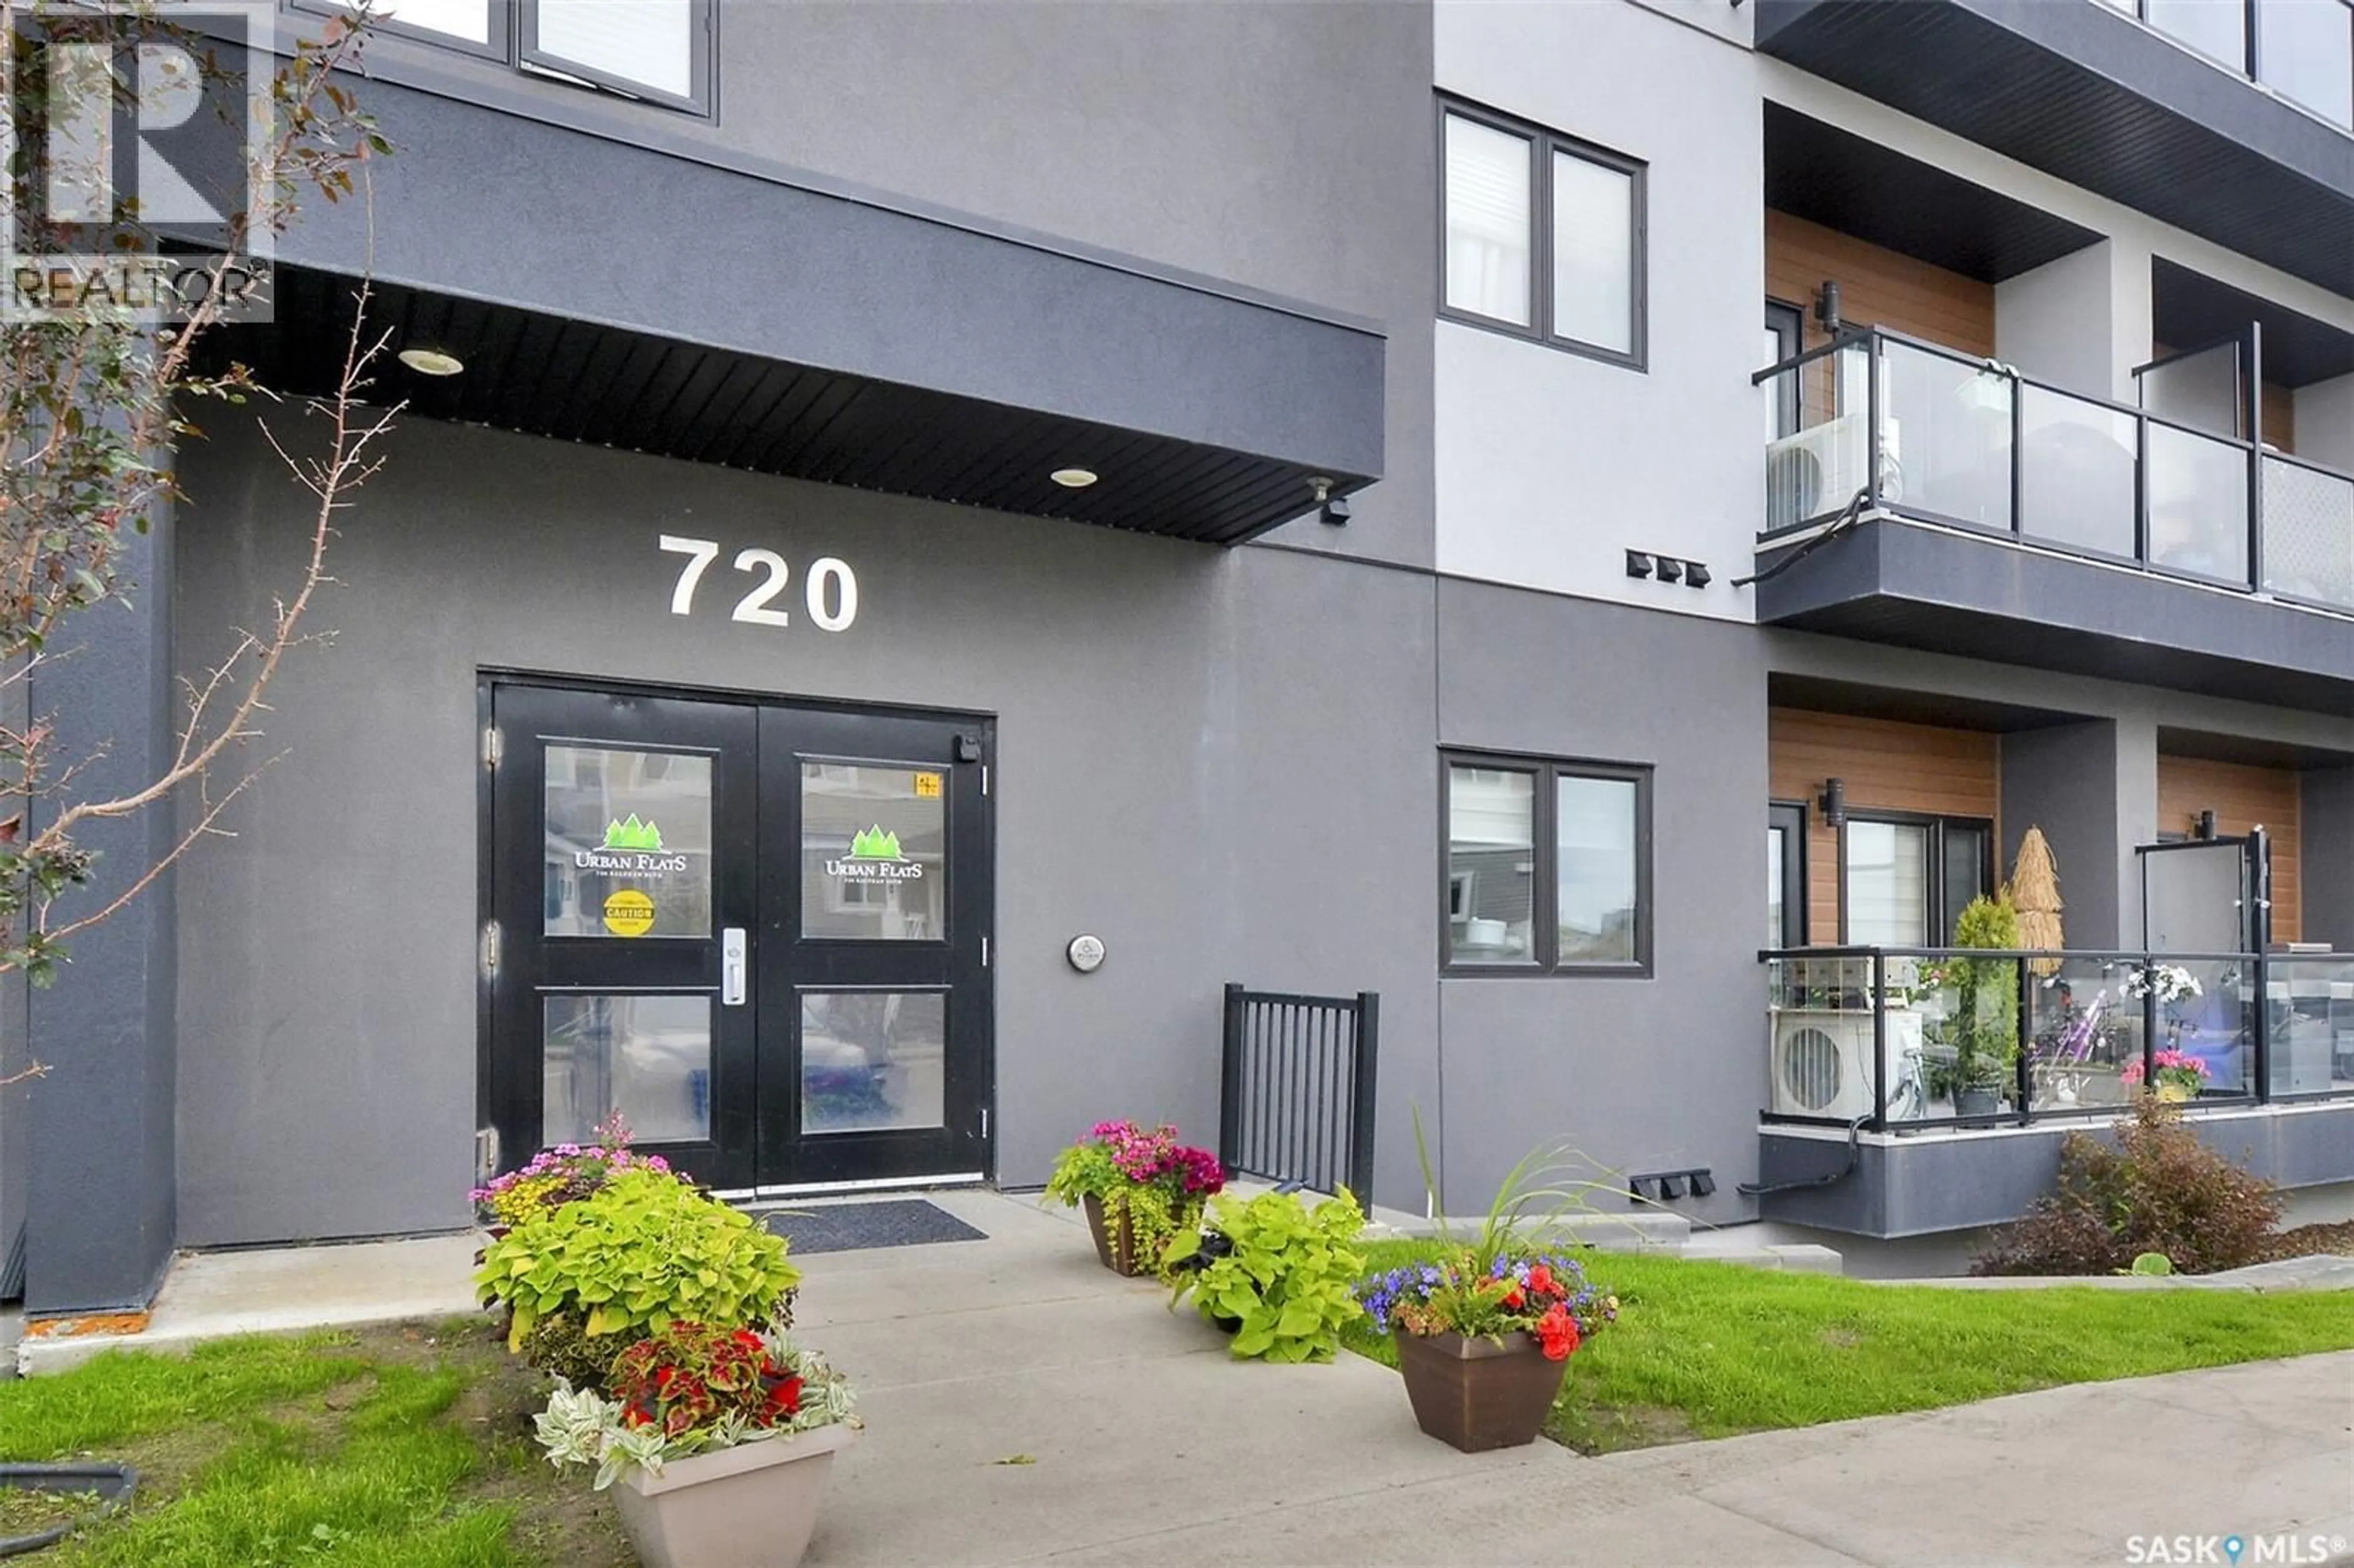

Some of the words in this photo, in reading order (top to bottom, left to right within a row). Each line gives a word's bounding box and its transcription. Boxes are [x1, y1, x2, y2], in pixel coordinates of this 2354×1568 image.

[659, 535, 858, 632] 720
[575, 851, 631, 869] URBAN
[637, 854, 687, 871] FLATS
[826, 860, 875, 876] URBAN
[879, 862, 923, 878] FLATS
[606, 908, 652, 918] CAUTION
